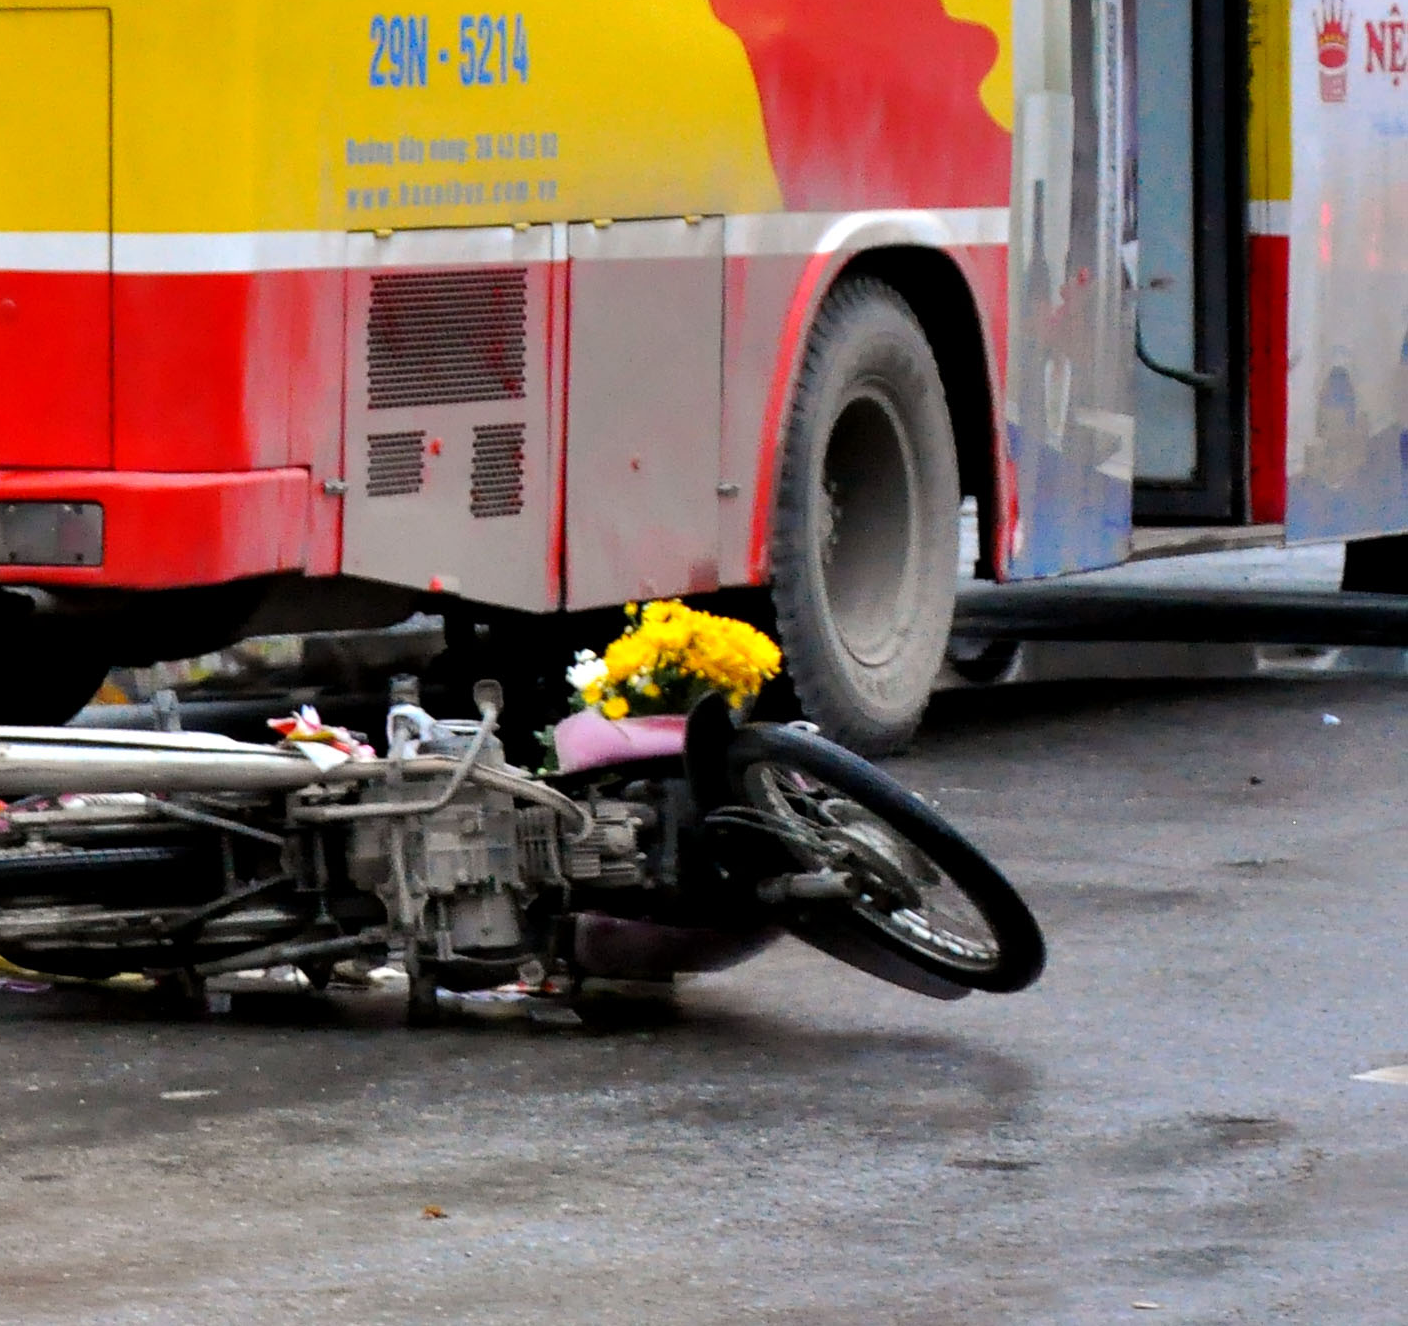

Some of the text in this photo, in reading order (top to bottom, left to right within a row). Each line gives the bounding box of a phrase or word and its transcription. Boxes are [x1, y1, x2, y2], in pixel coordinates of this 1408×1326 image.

[368, 13, 429, 88] 29N
[458, 11, 529, 87] 5214
[1365, 4, 1408, 87] NỆ
